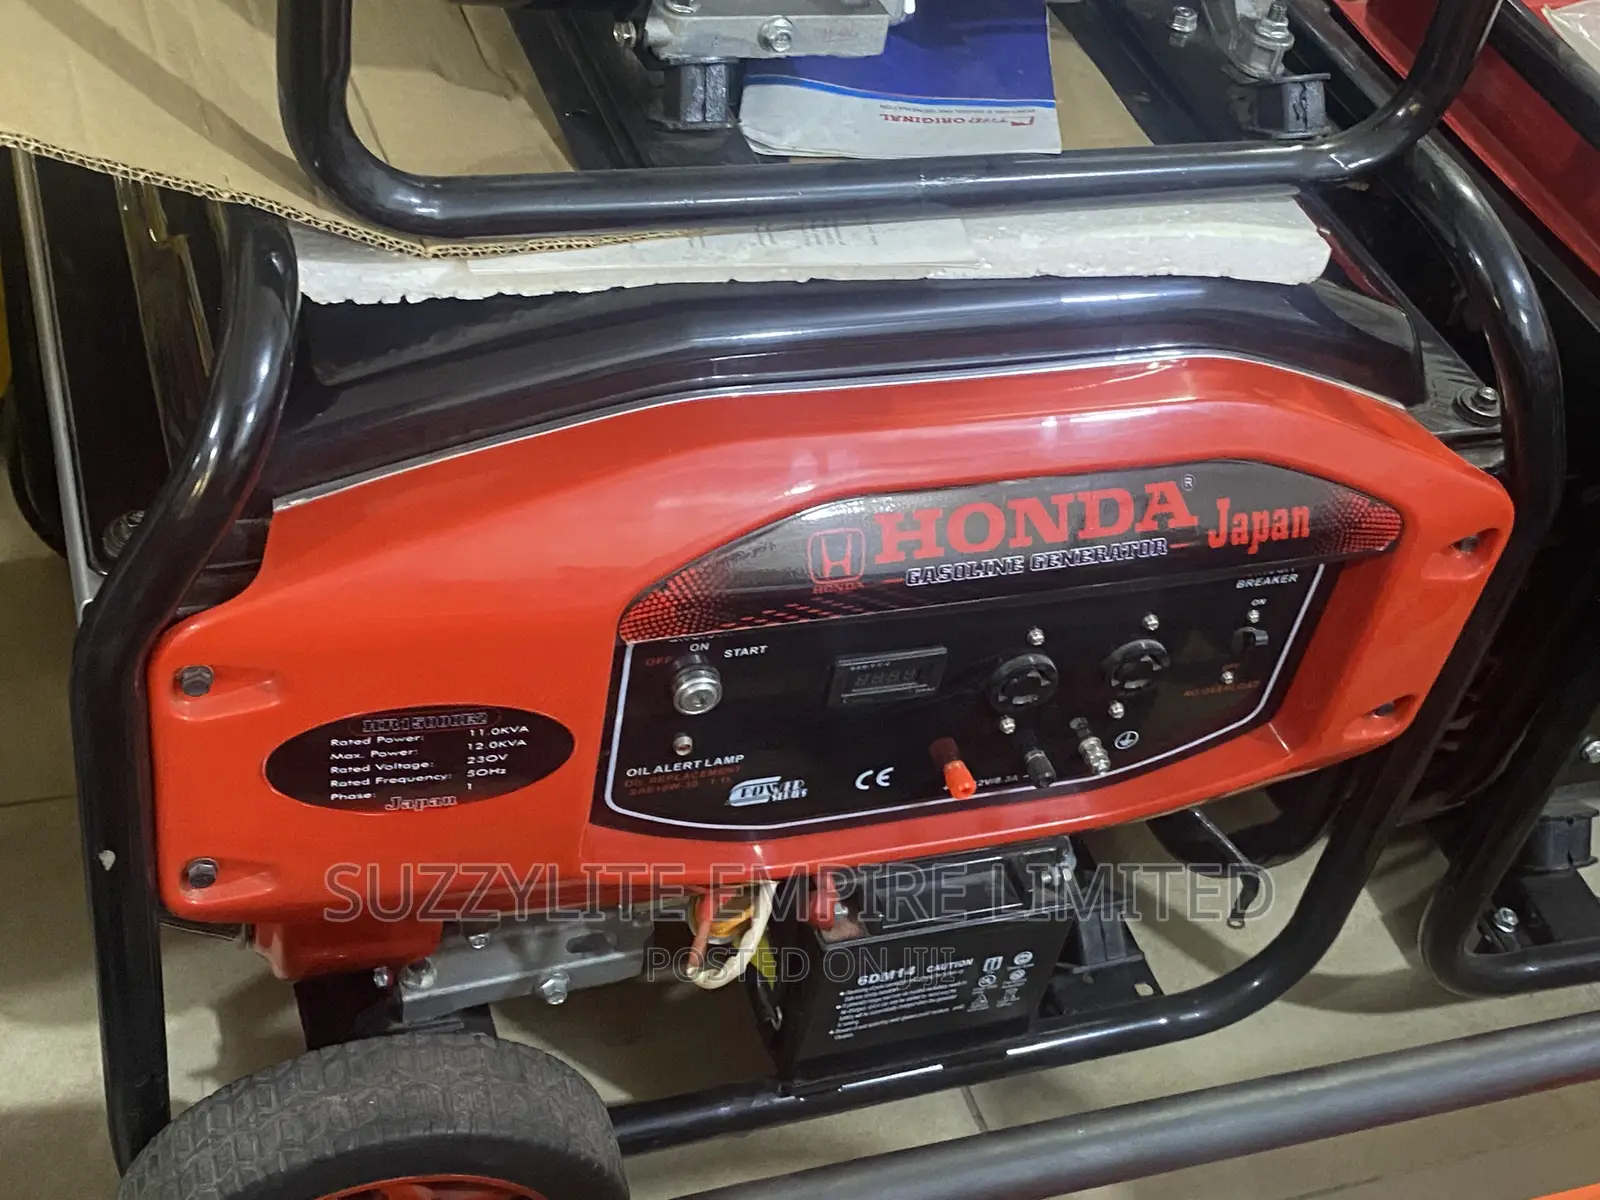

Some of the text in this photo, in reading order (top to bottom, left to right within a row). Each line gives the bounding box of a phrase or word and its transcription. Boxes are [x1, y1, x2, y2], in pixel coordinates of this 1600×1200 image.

[880, 113, 965, 124] ORIGINAL
[873, 480, 1199, 565] HONDA
[1207, 497, 1310, 554] Japan
[905, 538, 1168, 587] GASOLINE GENERATOR
[1235, 573, 1299, 589] BREAKER
[1251, 598, 1267, 606] ON
[689, 642, 710, 652] ON
[723, 645, 768, 658] START
[330, 725, 529, 747] Rated Power: 11.0KVA
[329, 739, 527, 761] Max. Power: 12.0KVA
[330, 753, 508, 774] Rated Voltage: 230V
[626, 754, 745, 777] OIL ALERT LAMP
[330, 777, 370, 788] Rated
[375, 773, 452, 786] Frequency:
[855, 767, 894, 790] CE
[330, 791, 376, 801] Phase:
[385, 795, 457, 812] Japan
[926, 958, 974, 973] CAUTION
